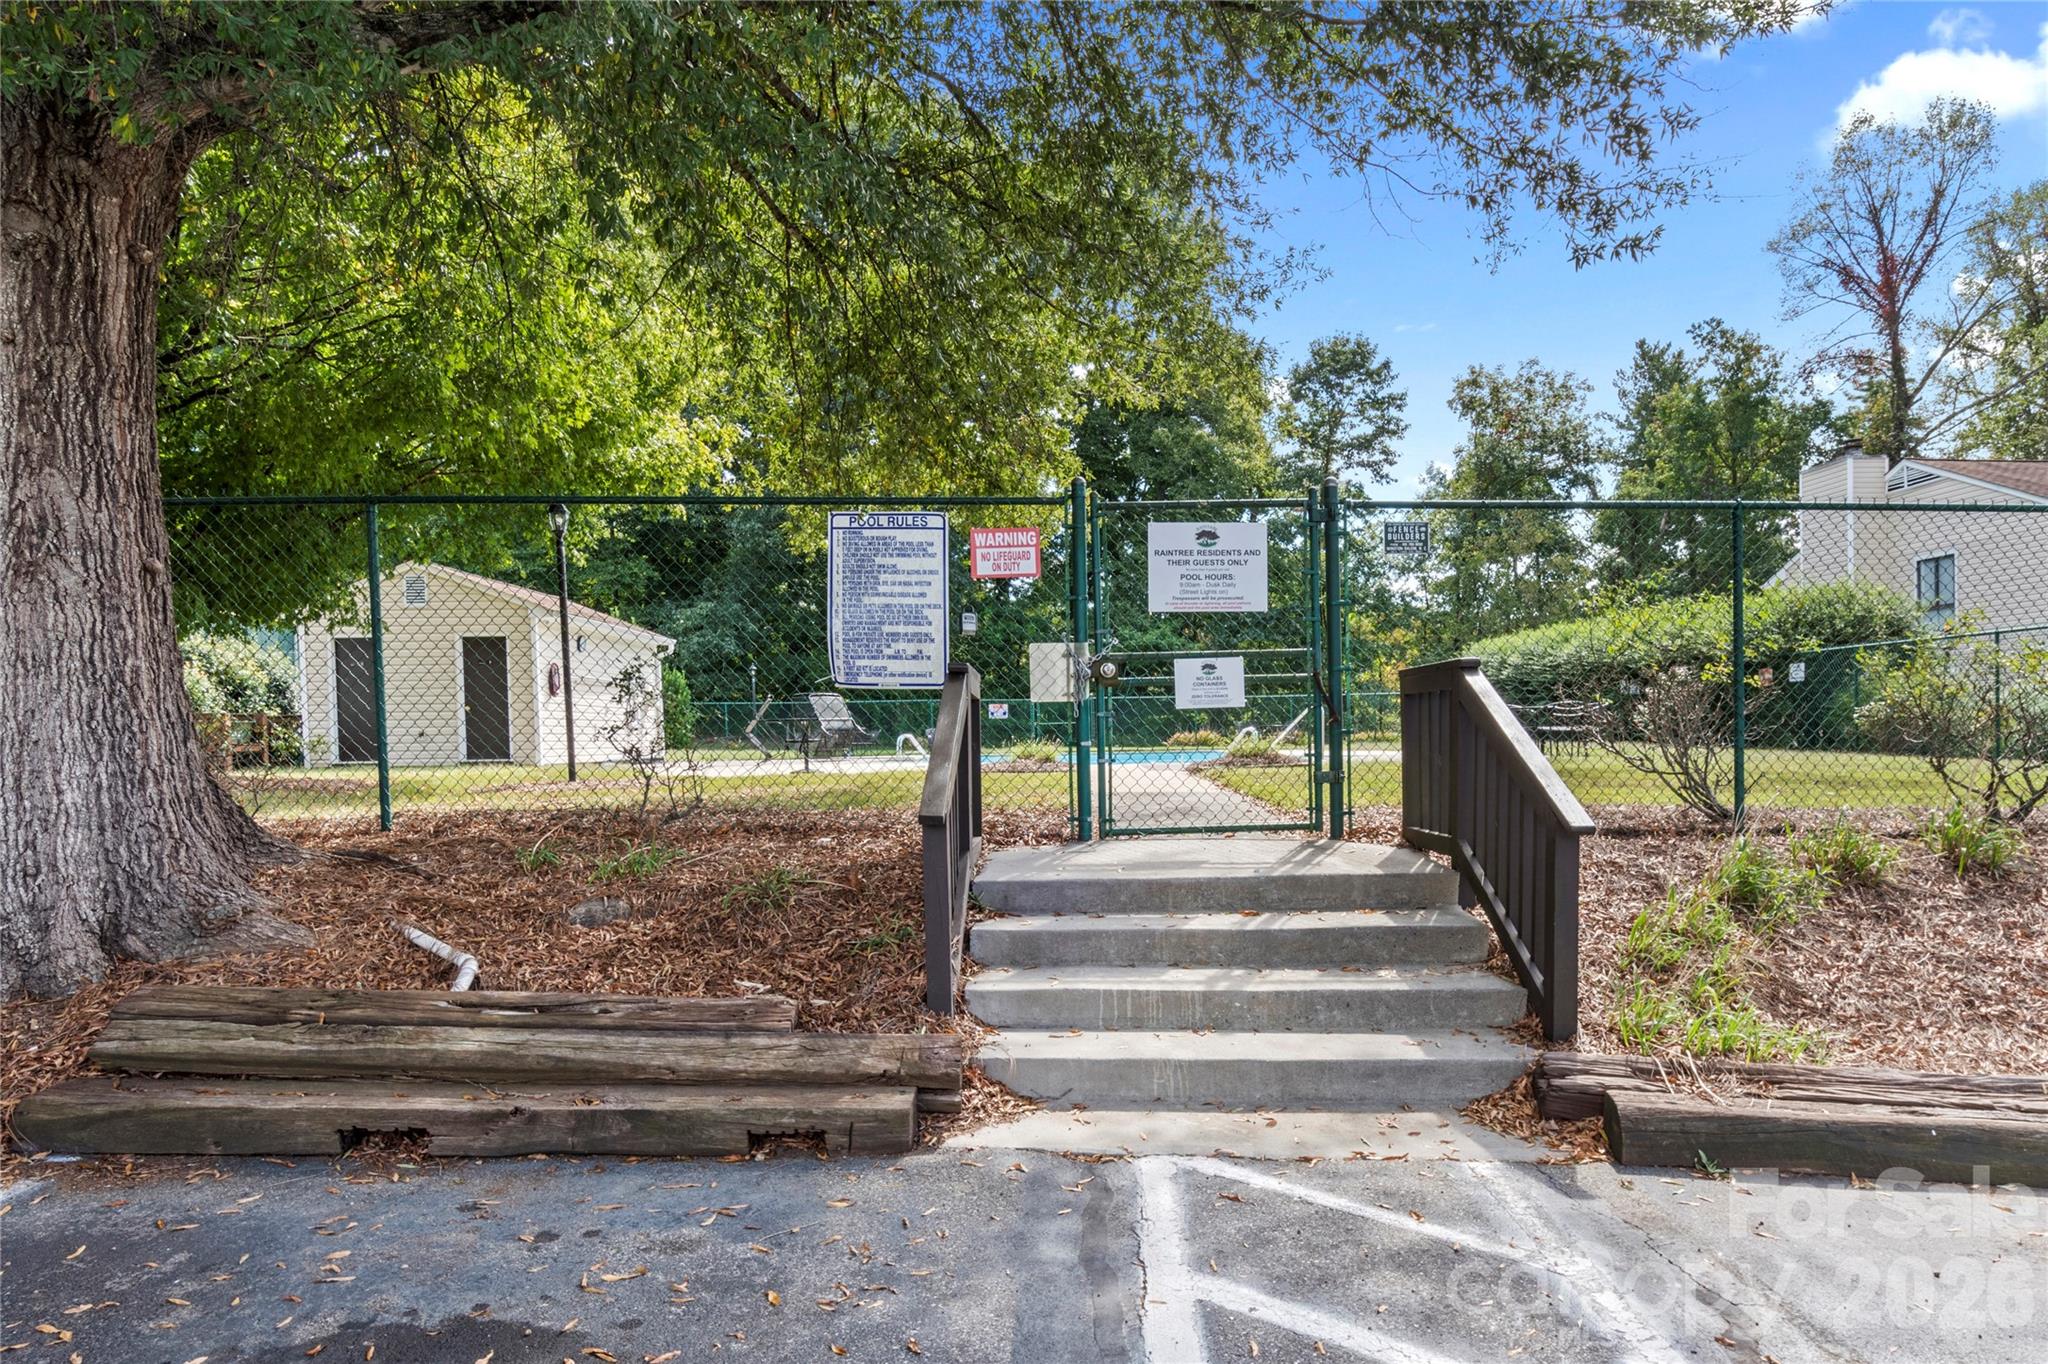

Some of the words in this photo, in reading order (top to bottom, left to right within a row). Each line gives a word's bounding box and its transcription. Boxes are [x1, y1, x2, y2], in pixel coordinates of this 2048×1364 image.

[849, 516, 884, 526] POOL
[888, 516, 928, 526] RULES
[974, 531, 1037, 548] WARNING
[980, 552, 991, 562] NO
[992, 550, 1031, 562] LIFEGUARD
[991, 562, 1002, 572] ON
[1004, 562, 1020, 572] DUTY
